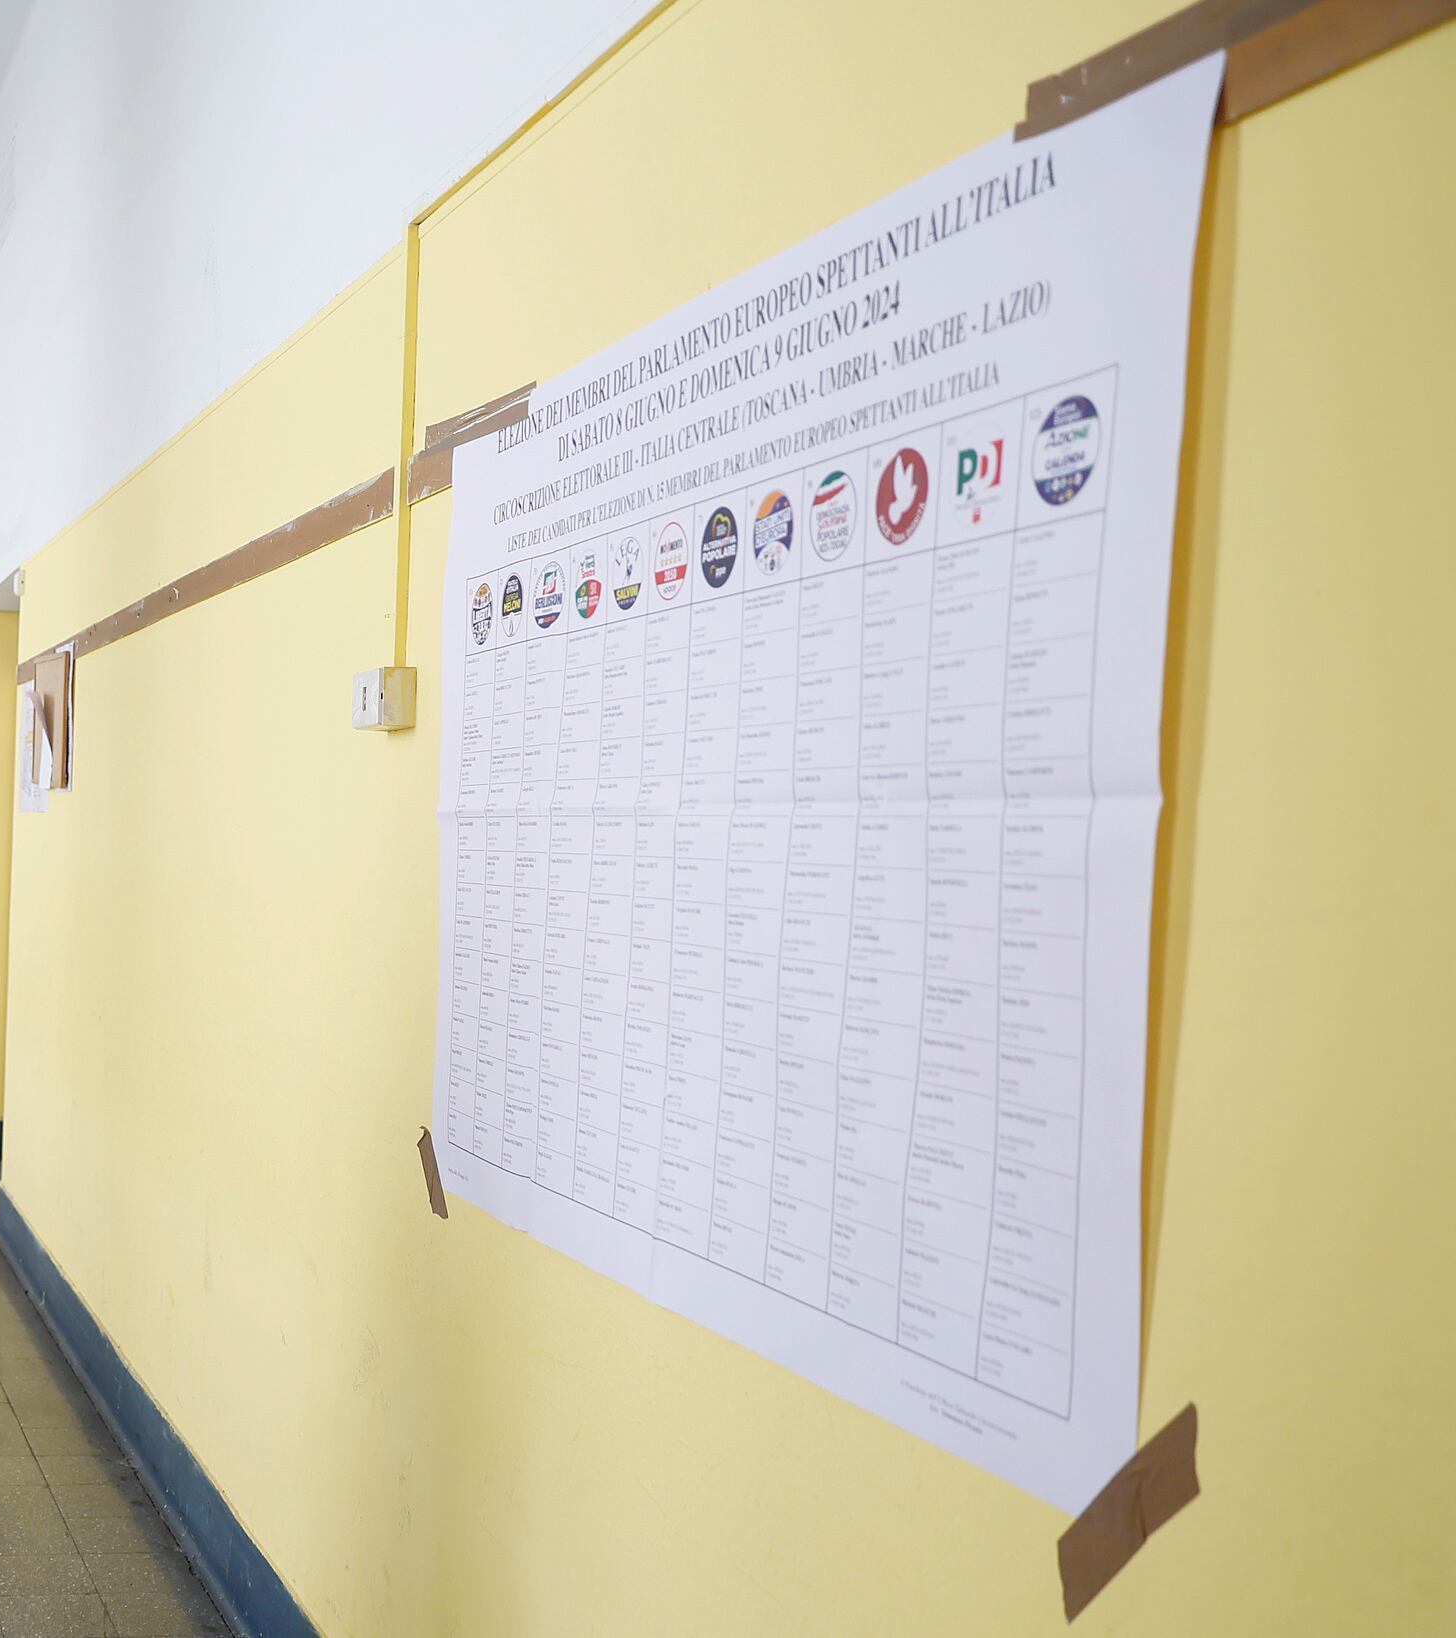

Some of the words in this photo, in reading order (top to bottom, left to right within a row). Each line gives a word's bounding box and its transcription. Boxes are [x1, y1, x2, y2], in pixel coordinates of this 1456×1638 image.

[493, 481, 562, 526] CIRCOSCRIZIONE
[562, 456, 621, 503] ELETTORALE
[622, 449, 634, 476] III
[641, 432, 676, 467] ITALIA
[677, 405, 740, 453] CENTRALE
[742, 378, 808, 432] (TOSCANA
[819, 349, 879, 397] UMBRIA
[892, 312, 967, 369] MARCHE
[982, 279, 1051, 334] LAZIO)
[497, 407, 545, 454] ELEZIONE
[545, 397, 563, 431] DEI
[564, 375, 610, 420] MEMBRI
[613, 364, 637, 401] DEL
[638, 312, 732, 385] PARLAMENTO
[735, 271, 812, 338] EUROPEO
[816, 216, 921, 299] SPETTANTI
[558, 432, 571, 462] DI
[571, 412, 614, 456] SABATO
[616, 407, 623, 436] 8
[625, 386, 676, 432] GIUGNO
[678, 378, 688, 409] E
[690, 340, 771, 404] DOMENICA
[774, 334, 783, 368] 9
[787, 300, 858, 362] GIUGNO
[862, 279, 900, 329] 2024
[507, 530, 526, 552] LISTE
[527, 525, 541, 548] DEI
[542, 514, 577, 545] CANDIDATI
[577, 509, 592, 531] PER
[637, 490, 646, 509] DI
[656, 481, 665, 502] 15
[666, 469, 703, 499] MEMBRI
[703, 460, 721, 485] DEL
[722, 434, 792, 478] PARLAMENTO
[794, 414, 846, 453] EUROPEO
[848, 389, 918, 434] SPETTANTI
[702, 544, 736, 563] POPOLARE
[616, 584, 639, 601] SALVINI
